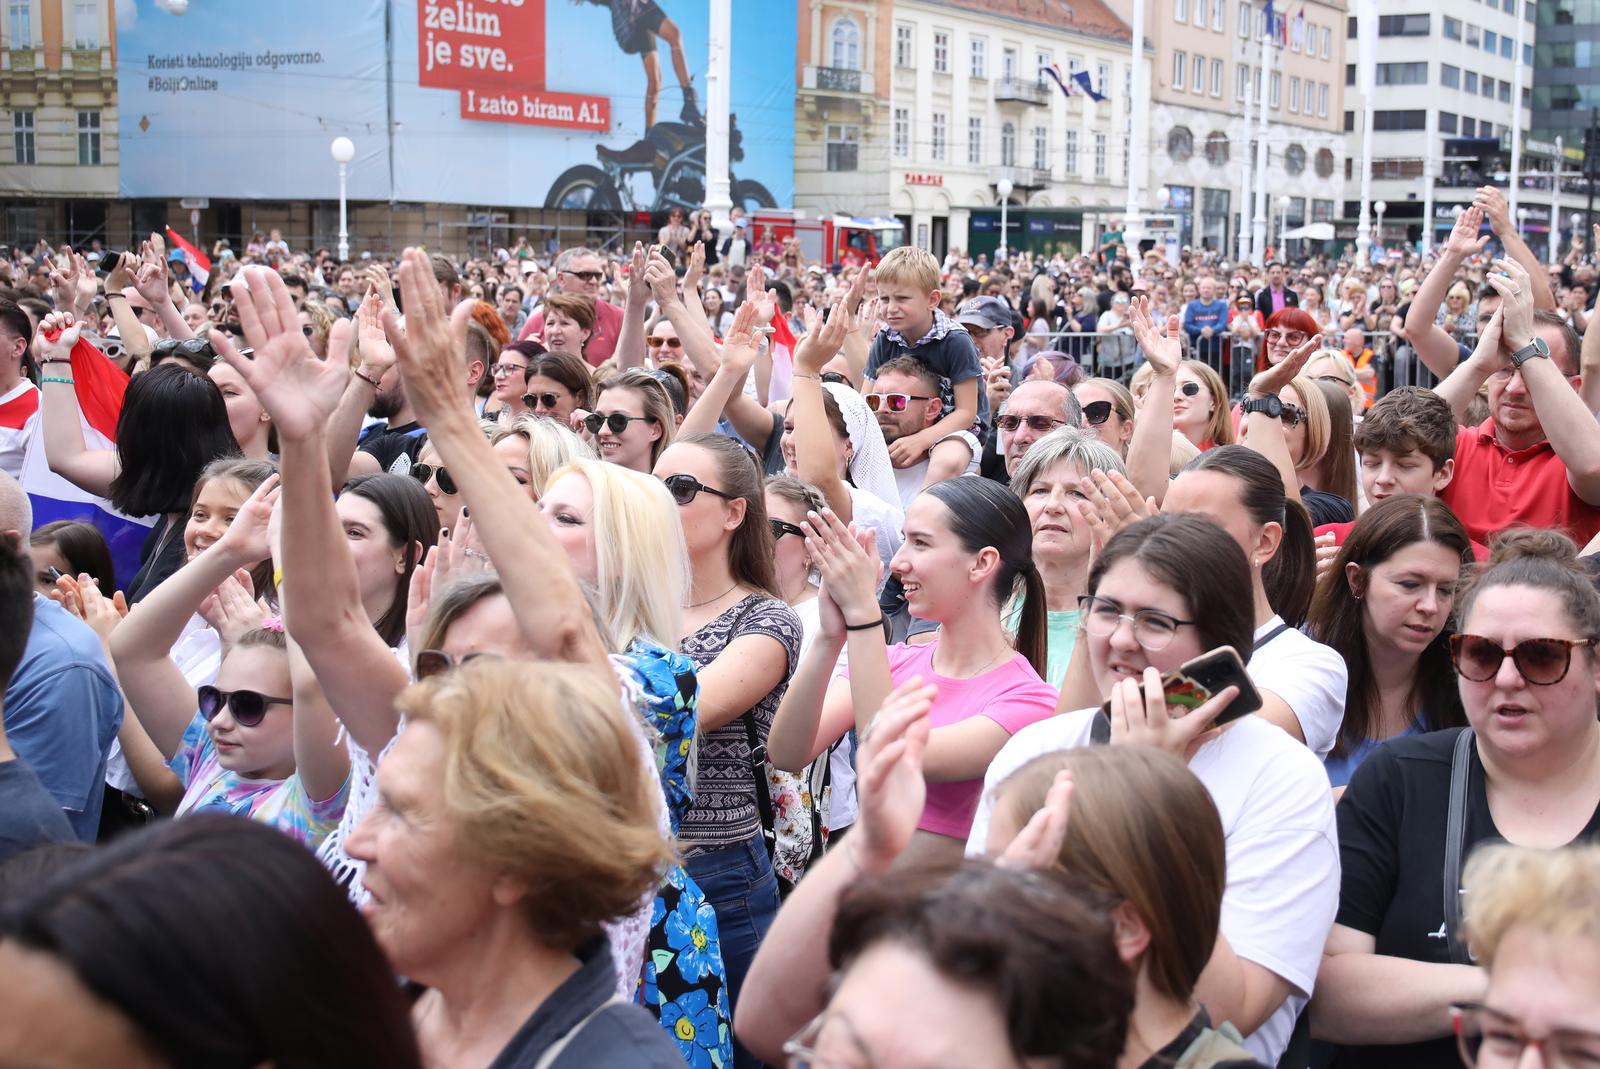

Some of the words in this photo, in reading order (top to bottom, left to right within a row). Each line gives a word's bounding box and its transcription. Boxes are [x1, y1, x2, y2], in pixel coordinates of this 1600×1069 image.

[424, 0, 501, 37] želim
[147, 54, 184, 70] Koristi
[187, 52, 253, 71] tehnologiju
[256, 50, 325, 69] odgovorno.
[425, 31, 452, 71] je
[460, 43, 514, 72] sve.
[467, 90, 475, 112] I
[479, 95, 518, 116] zato
[522, 95, 574, 121] biram
[577, 101, 606, 124] A1.
